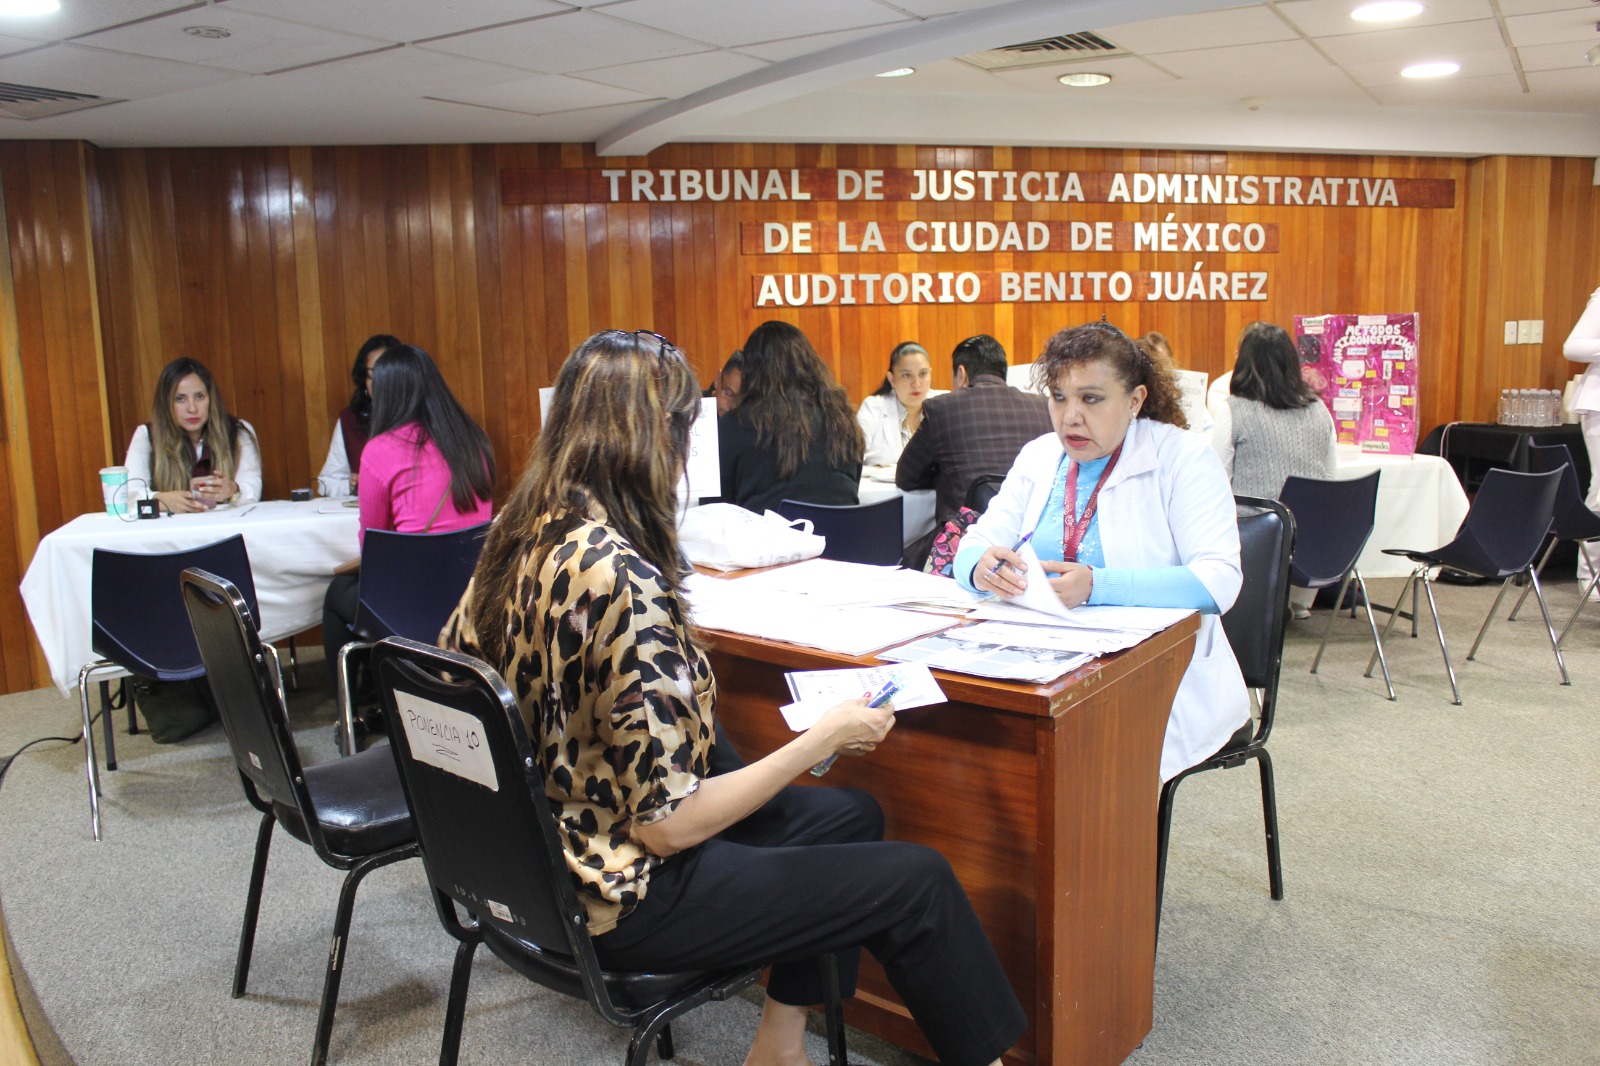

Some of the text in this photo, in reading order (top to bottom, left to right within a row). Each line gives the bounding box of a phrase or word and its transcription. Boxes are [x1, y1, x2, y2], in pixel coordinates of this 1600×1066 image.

[602, 169, 1399, 206] TRIBUNAL DE JUSTICIA ADMINISTRATIVA
[763, 213, 1266, 254] DE LA CIUDAD DE MÉXICO
[756, 262, 1268, 306] AUDITORIO BENITO JUÁREZ
[407, 710, 480, 750] PONENCIA 10
